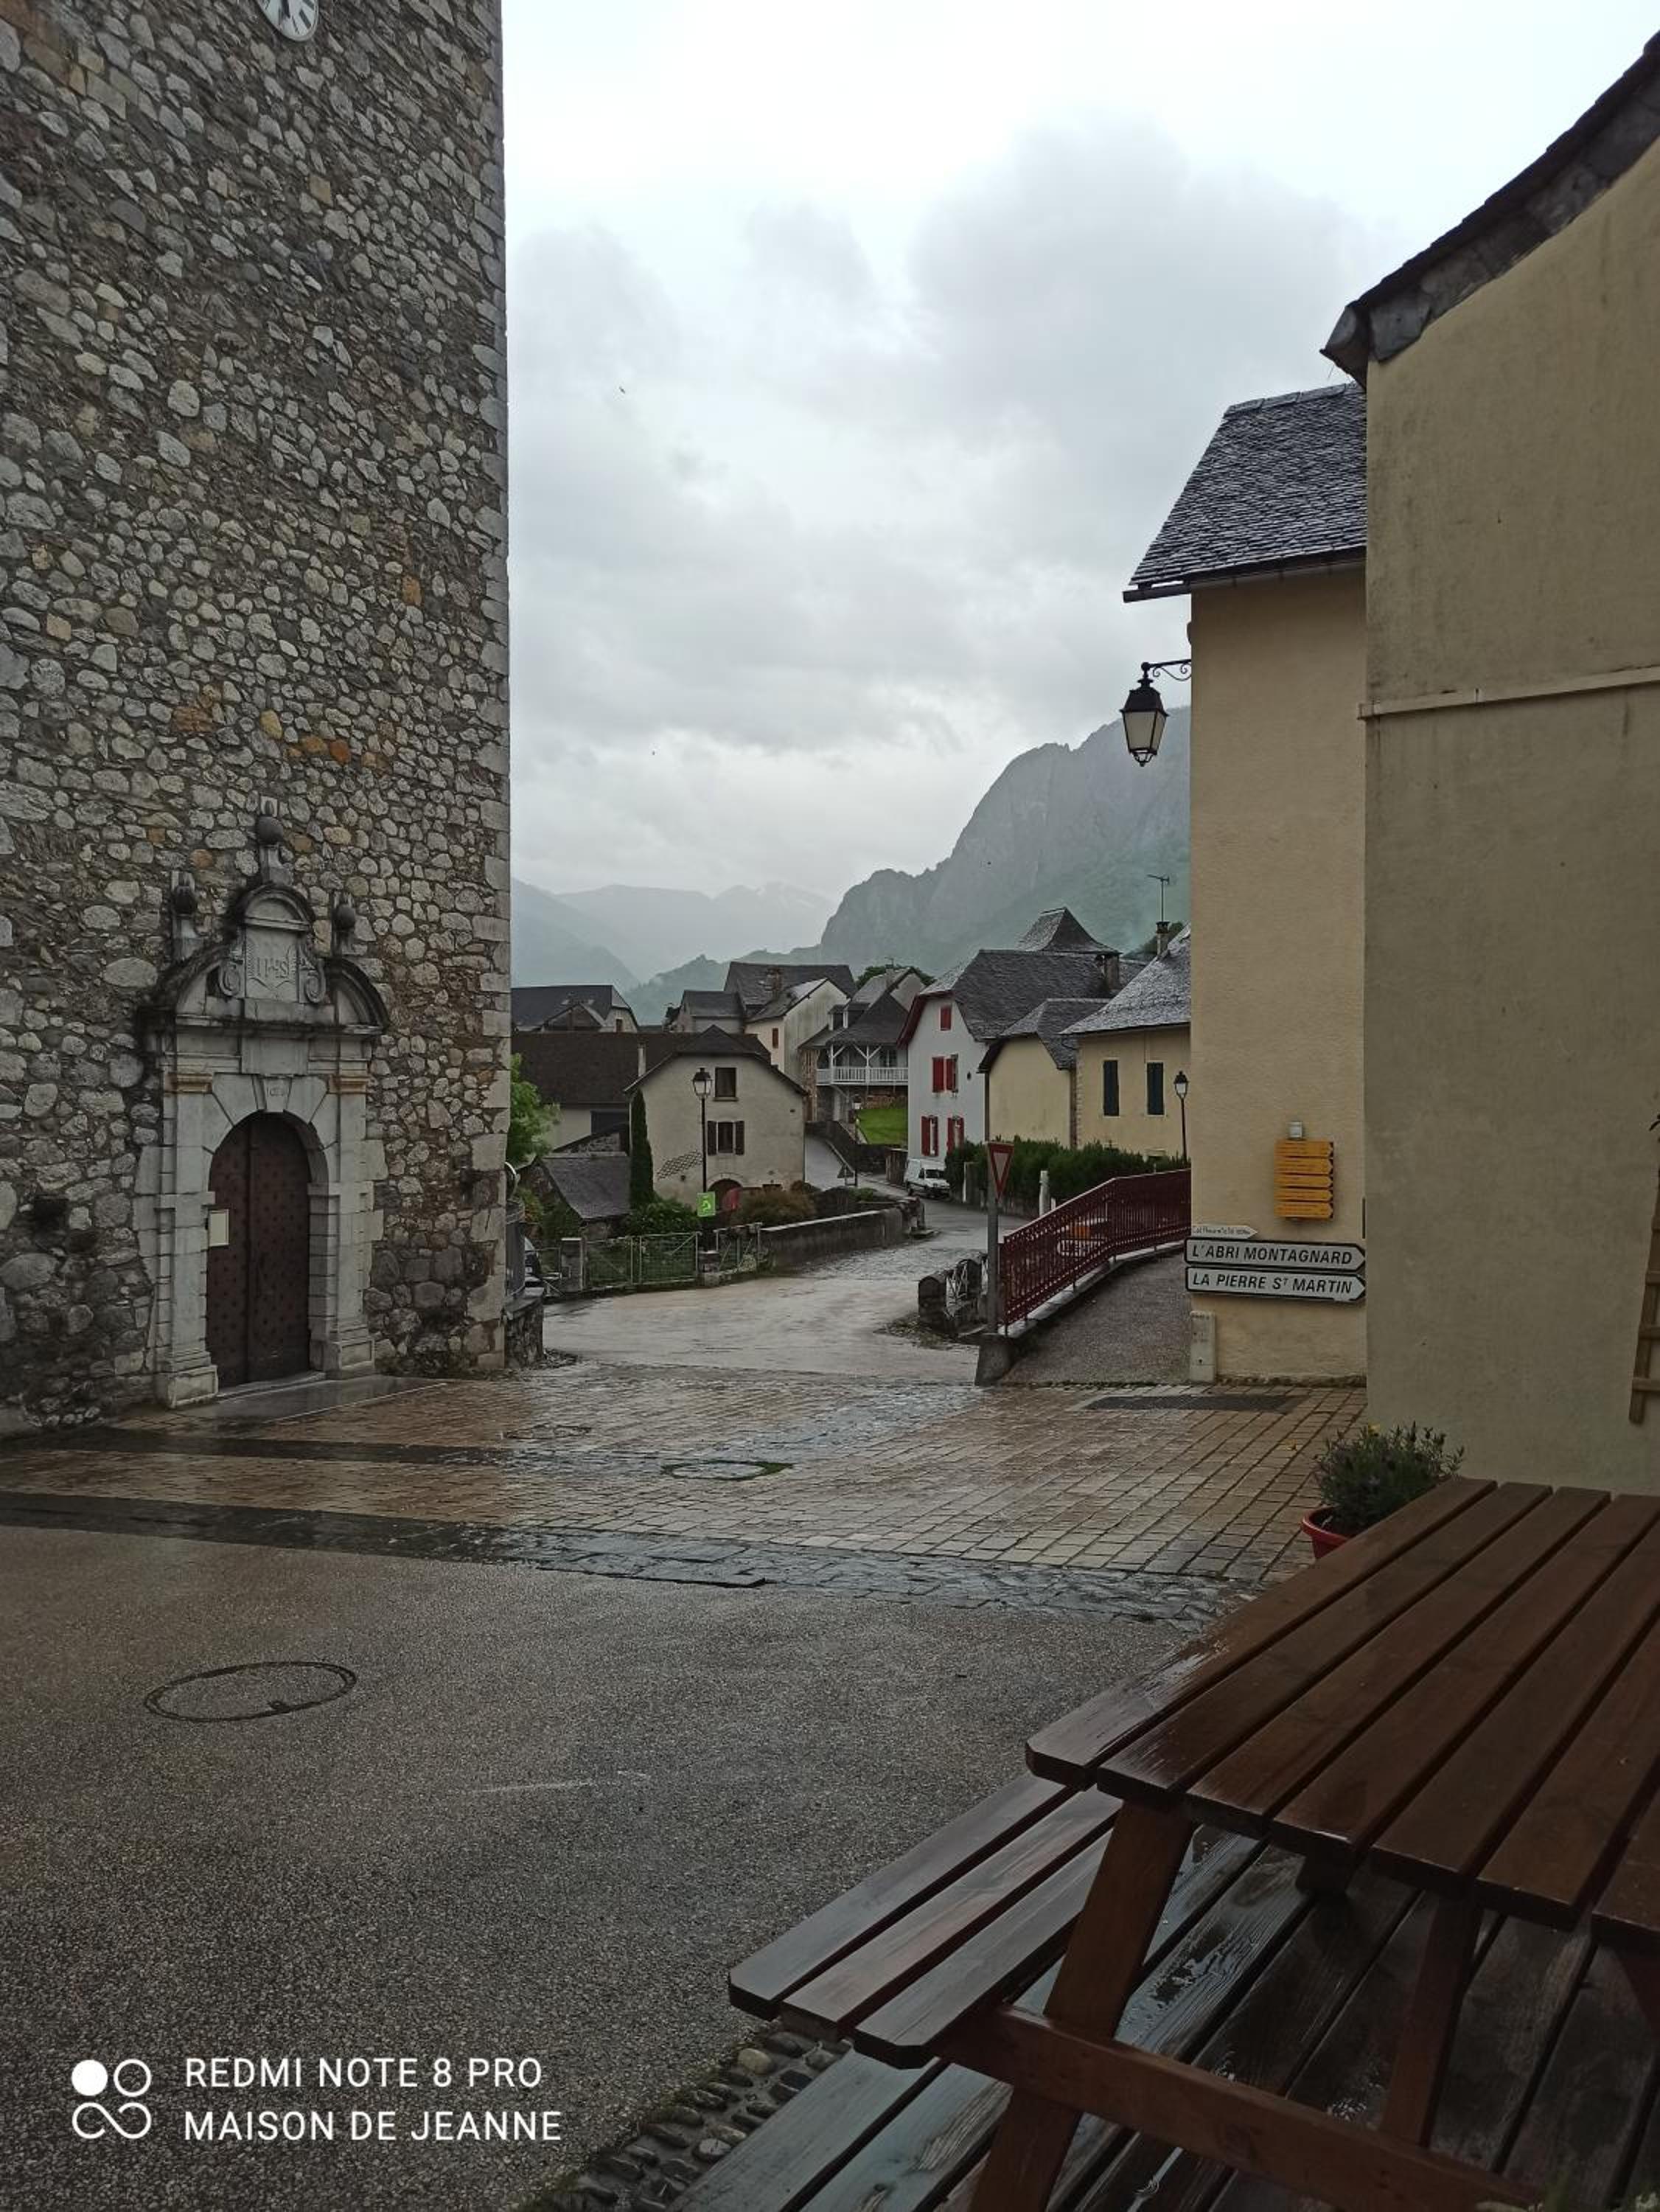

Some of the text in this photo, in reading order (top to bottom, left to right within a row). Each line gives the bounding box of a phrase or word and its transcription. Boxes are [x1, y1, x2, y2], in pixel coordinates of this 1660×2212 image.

[1192, 1245, 1353, 1265] L'ABRI MONTAGNARD
[1193, 1273, 1210, 1286] LA
[1216, 1273, 1267, 1289] PIERRE
[1292, 1278, 1353, 1294] MARTIN
